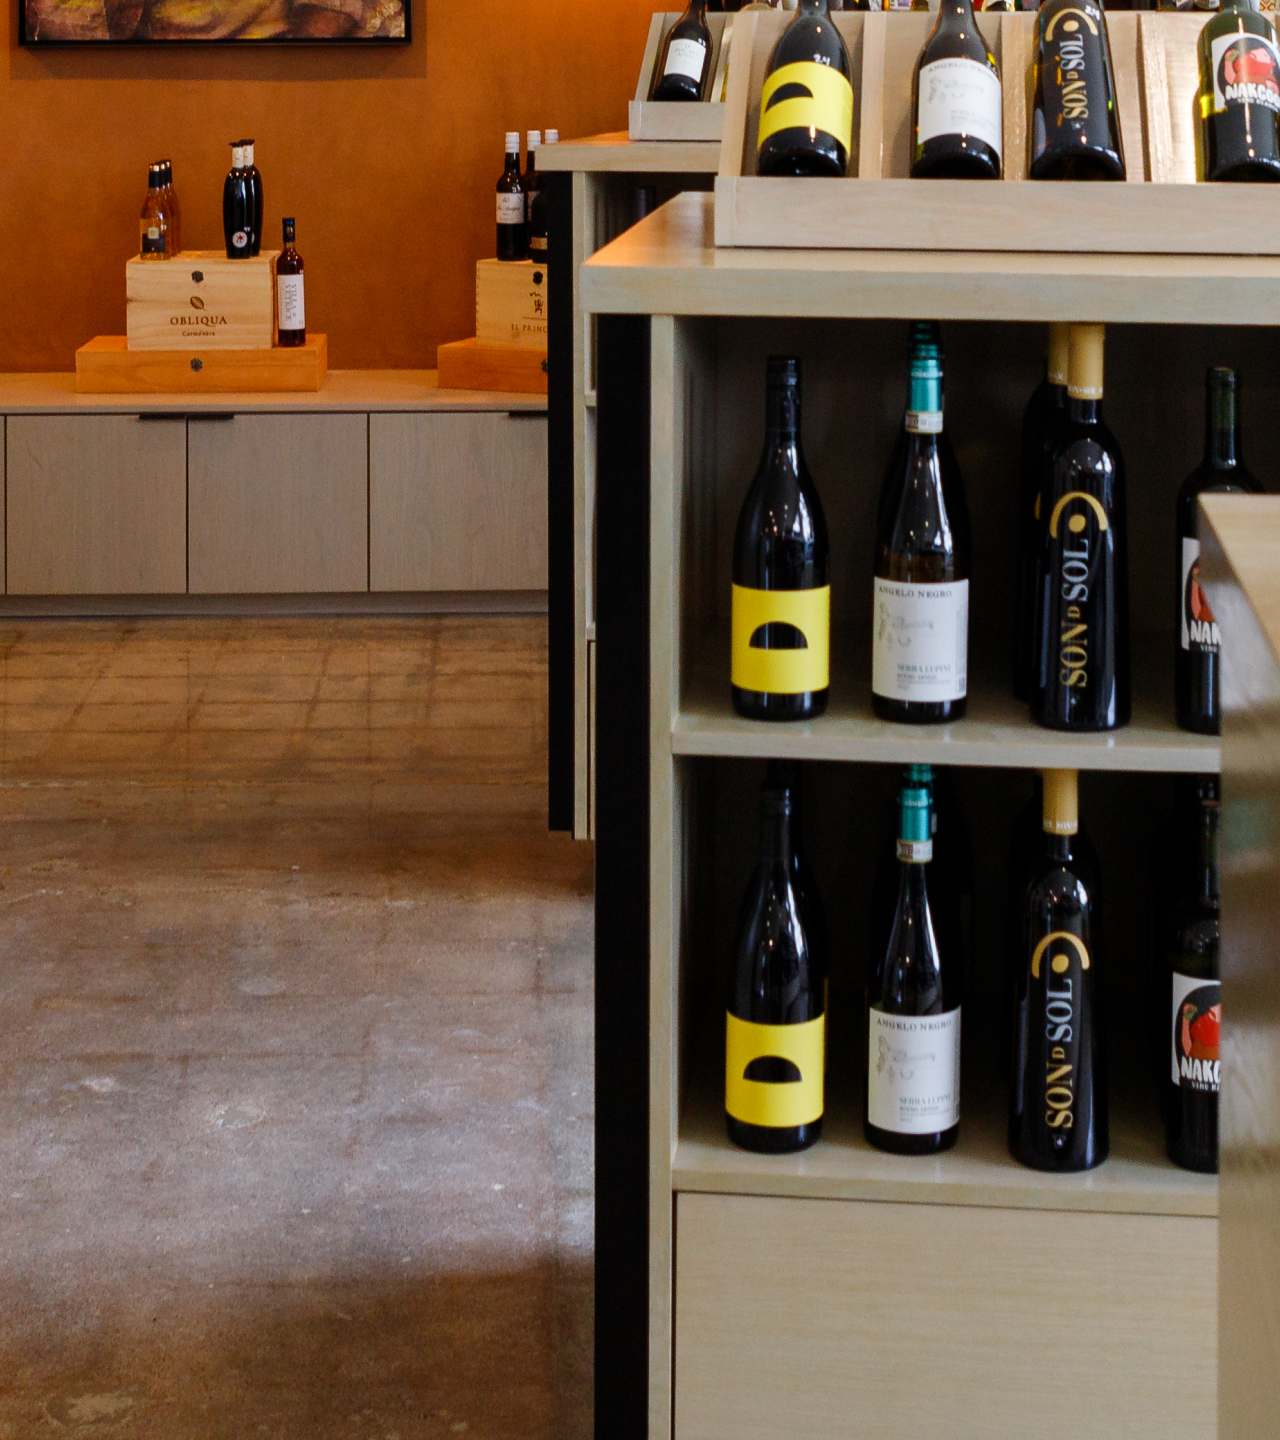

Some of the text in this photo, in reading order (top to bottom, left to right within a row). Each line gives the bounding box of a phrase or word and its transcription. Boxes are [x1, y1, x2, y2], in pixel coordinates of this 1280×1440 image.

[1058, 34, 1086, 71] SOL
[1061, 79, 1089, 120] SON
[169, 316, 228, 328] OBLIQUA
[878, 586, 915, 598] ANGELO
[1061, 539, 1089, 604] SOL
[1059, 623, 1088, 689] SON
[877, 1018, 917, 1032] ANGELO
[1045, 979, 1073, 1043] SOL
[1045, 1063, 1074, 1129] SON
